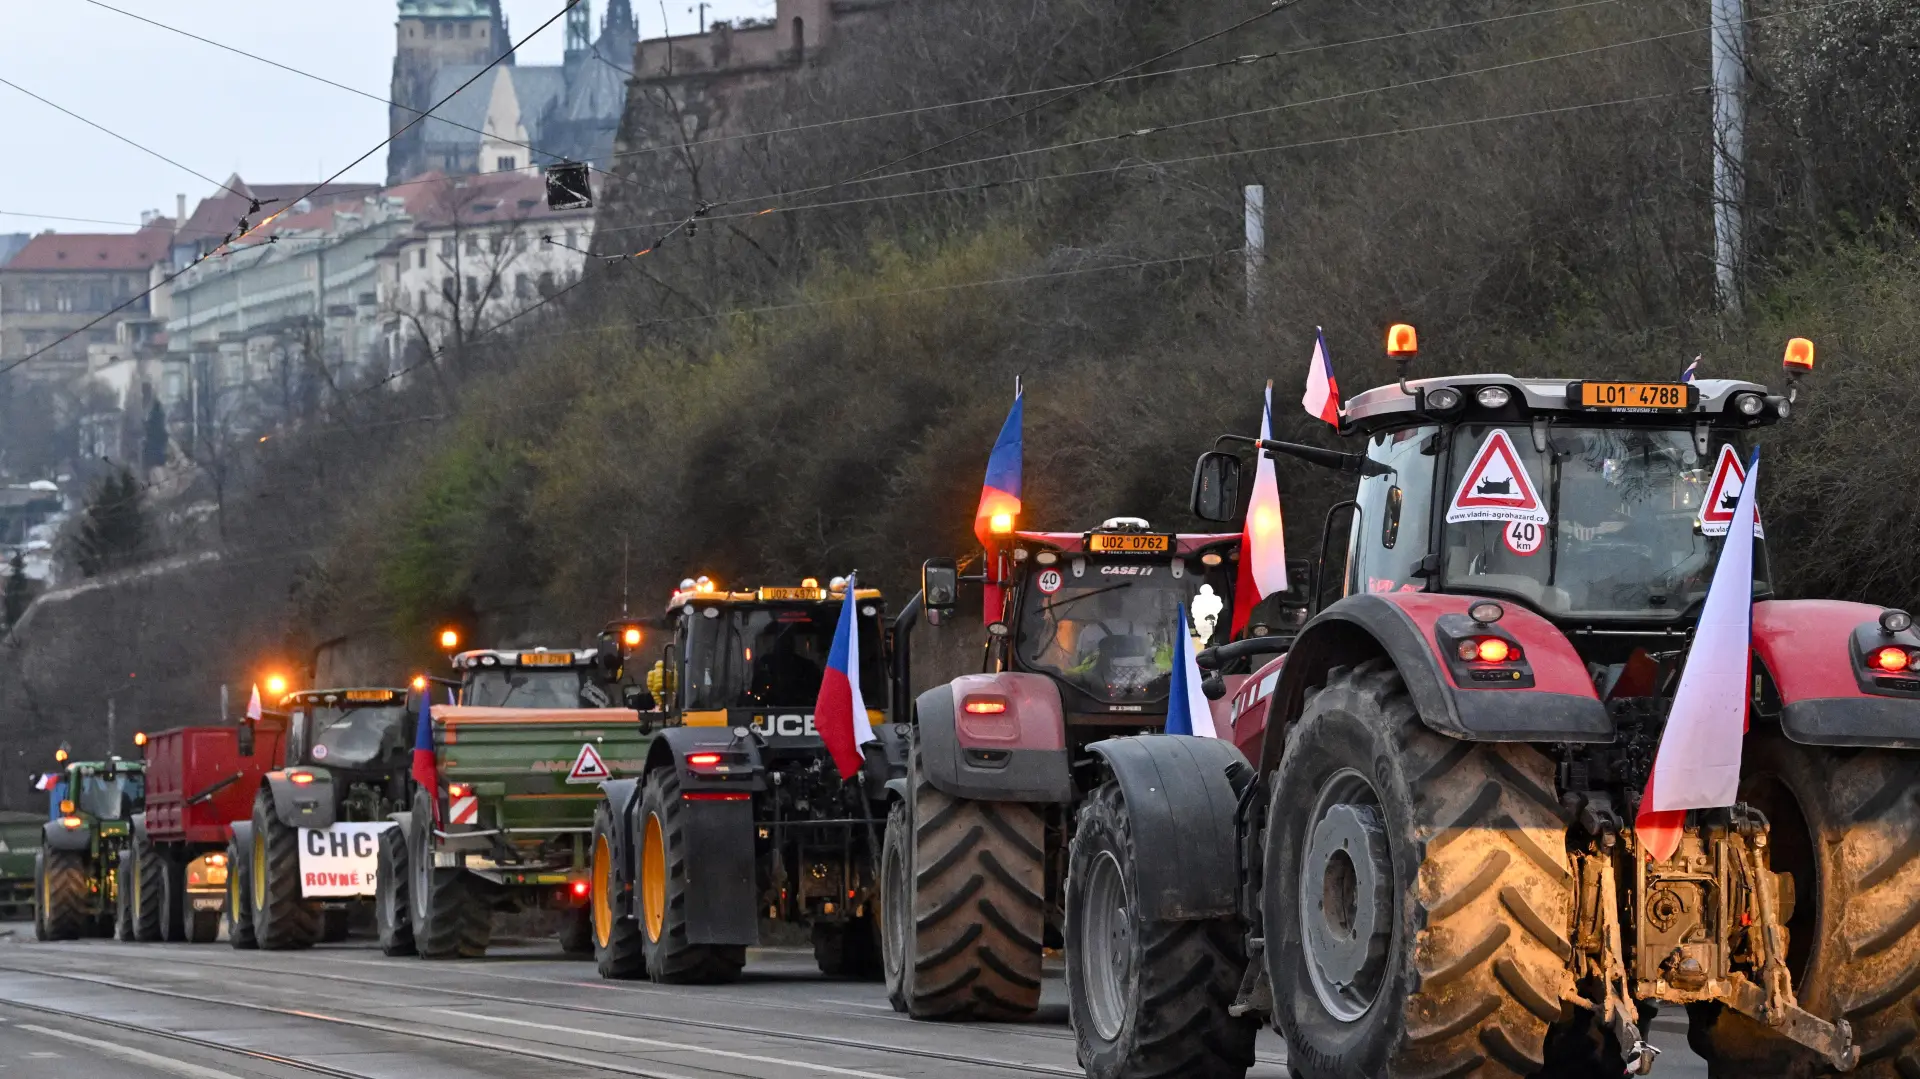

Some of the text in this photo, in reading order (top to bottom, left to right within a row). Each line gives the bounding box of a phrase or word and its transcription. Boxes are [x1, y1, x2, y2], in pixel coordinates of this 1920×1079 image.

[1596, 385, 1679, 405] L01 4788
[1511, 522, 1535, 542] 40
[1133, 537, 1163, 549] 0762
[1516, 541, 1531, 550] km
[1100, 565, 1139, 575] CASE
[1041, 572, 1057, 585] 40
[366, 872, 377, 885] P
